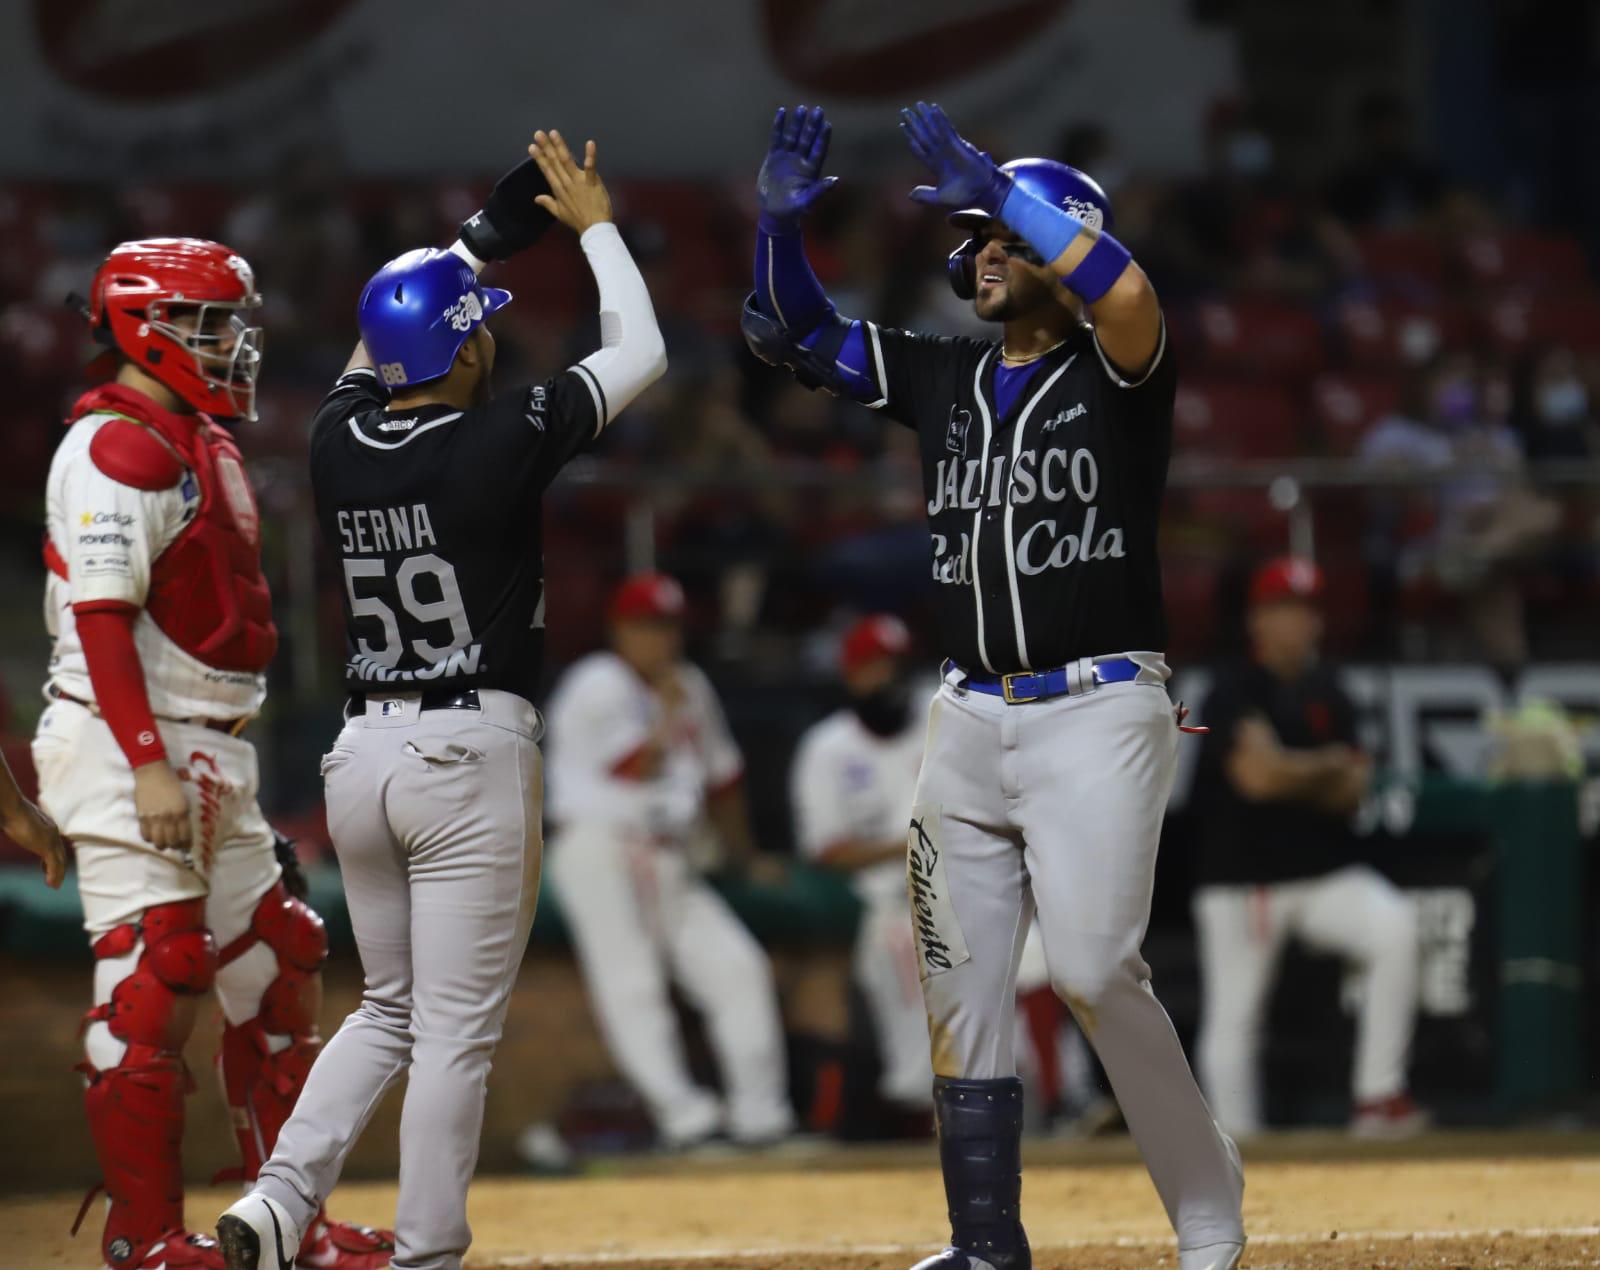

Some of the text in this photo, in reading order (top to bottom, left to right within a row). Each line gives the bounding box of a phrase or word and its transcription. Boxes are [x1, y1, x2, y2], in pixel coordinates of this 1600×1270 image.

[380, 362, 408, 385] 88
[927, 447, 1099, 517] JALISCO
[337, 503, 437, 553] SERNA
[930, 506, 1126, 585] Red Cola
[342, 553, 475, 669] 59
[910, 816, 953, 969] Caliente
